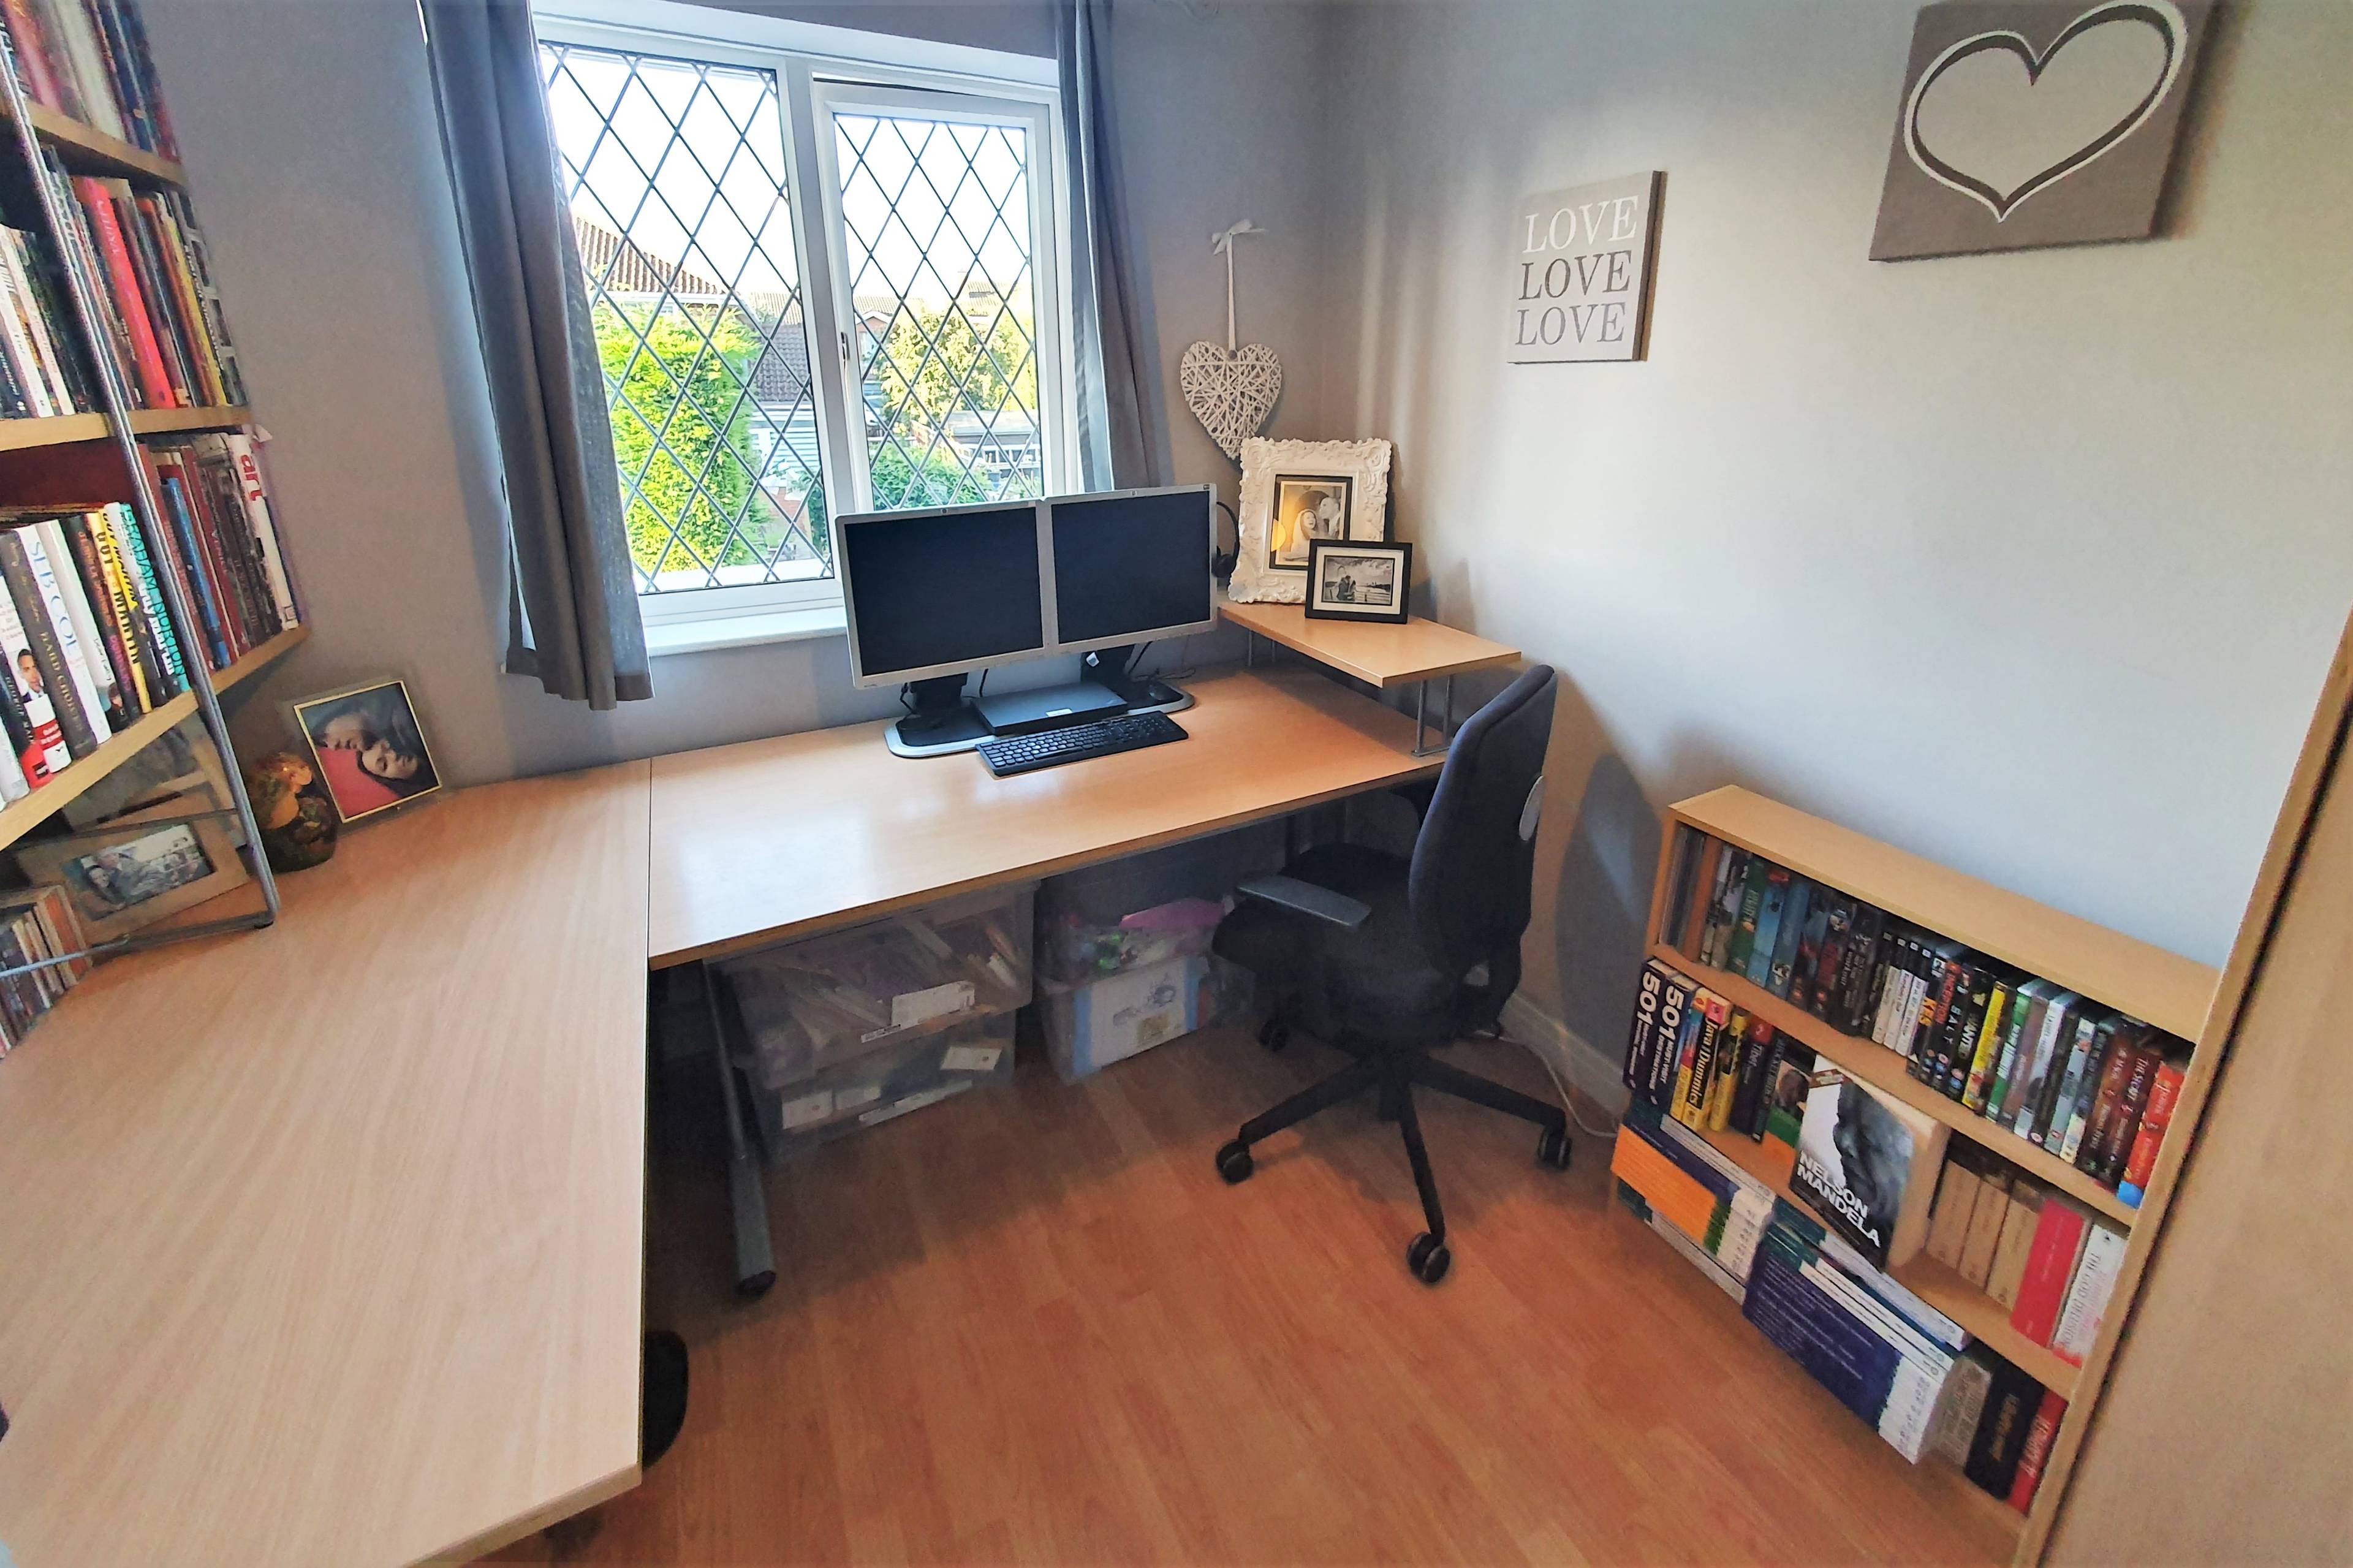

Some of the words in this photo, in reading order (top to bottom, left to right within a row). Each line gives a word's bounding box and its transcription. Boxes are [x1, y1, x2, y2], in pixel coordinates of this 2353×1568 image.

[1522, 195, 1639, 254] LOVE
[1518, 250, 1632, 300] LOVE
[1515, 302, 1626, 346] LOVE
[241, 455, 263, 501] art
[29, 540, 56, 588] SEB
[120, 505, 157, 591] GRAHAM
[152, 600, 186, 675] NORTON
[39, 631, 61, 672] HARD
[1635, 971, 1661, 1026] 501
[1658, 985, 1685, 1042] 501
[1702, 1017, 1718, 1048] Java
[1648, 1034, 1664, 1091] DESTINATIONS
[1689, 1054, 1711, 1103] Dummies
[1797, 1163, 1881, 1248] MANDELA
[1800, 1150, 1868, 1218] NELSON
[2086, 1252, 2102, 1273] THE
